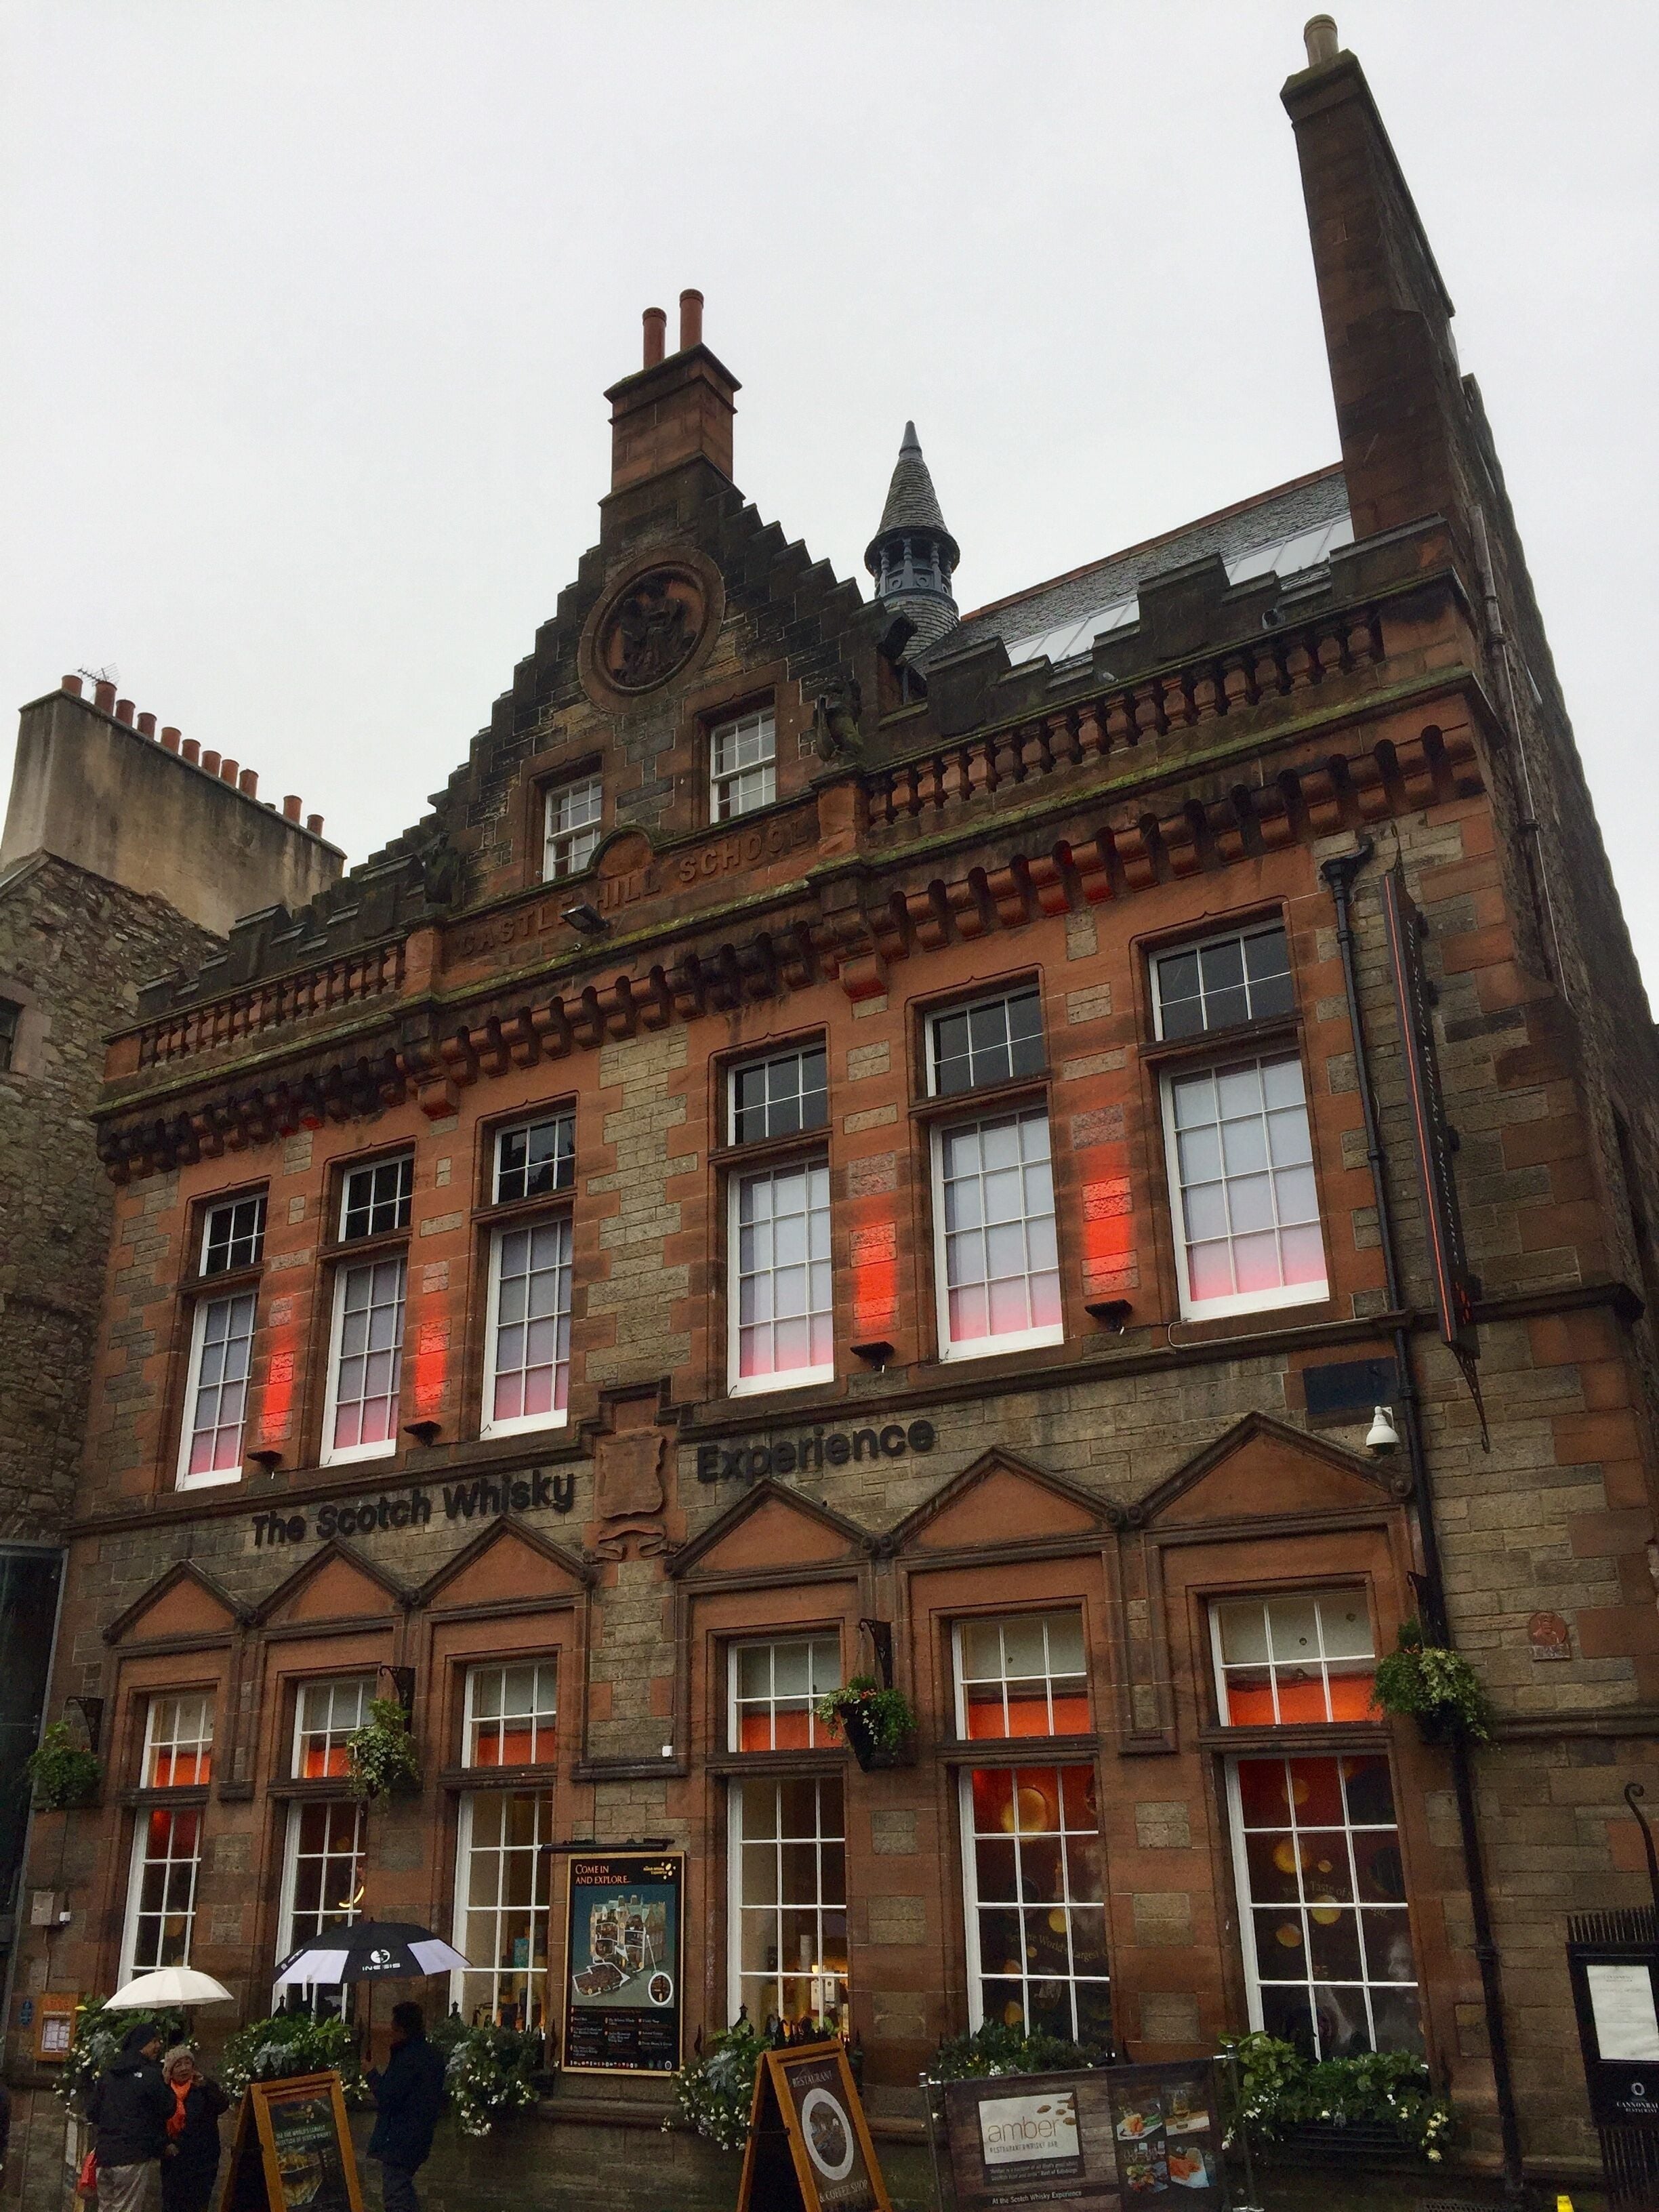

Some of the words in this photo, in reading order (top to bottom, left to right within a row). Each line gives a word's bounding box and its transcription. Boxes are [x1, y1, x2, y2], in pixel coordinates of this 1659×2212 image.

[458, 892, 575, 956] CASTLE
[595, 869, 660, 910] HILL
[679, 819, 809, 883] SCHOOL
[697, 1420, 935, 1487] Experience
[252, 1511, 306, 1547] The
[316, 1489, 432, 1540] Scotch
[443, 1469, 574, 1520] Whisky
[575, 1864, 599, 1875] COME
[600, 1865, 609, 1873] IN
[575, 1876, 593, 1884] AND
[362, 1963, 401, 1971] INESIS
[792, 2070, 833, 2087] RESTAURANT
[988, 2116, 1059, 2143] amber
[825, 2184, 850, 2201] COFFEE
[851, 2179, 868, 2193] SHOP
[1010, 2195, 1029, 2203] Scotch
[1030, 2193, 1050, 2201] Whisky
[1052, 2190, 1082, 2199] Experience
